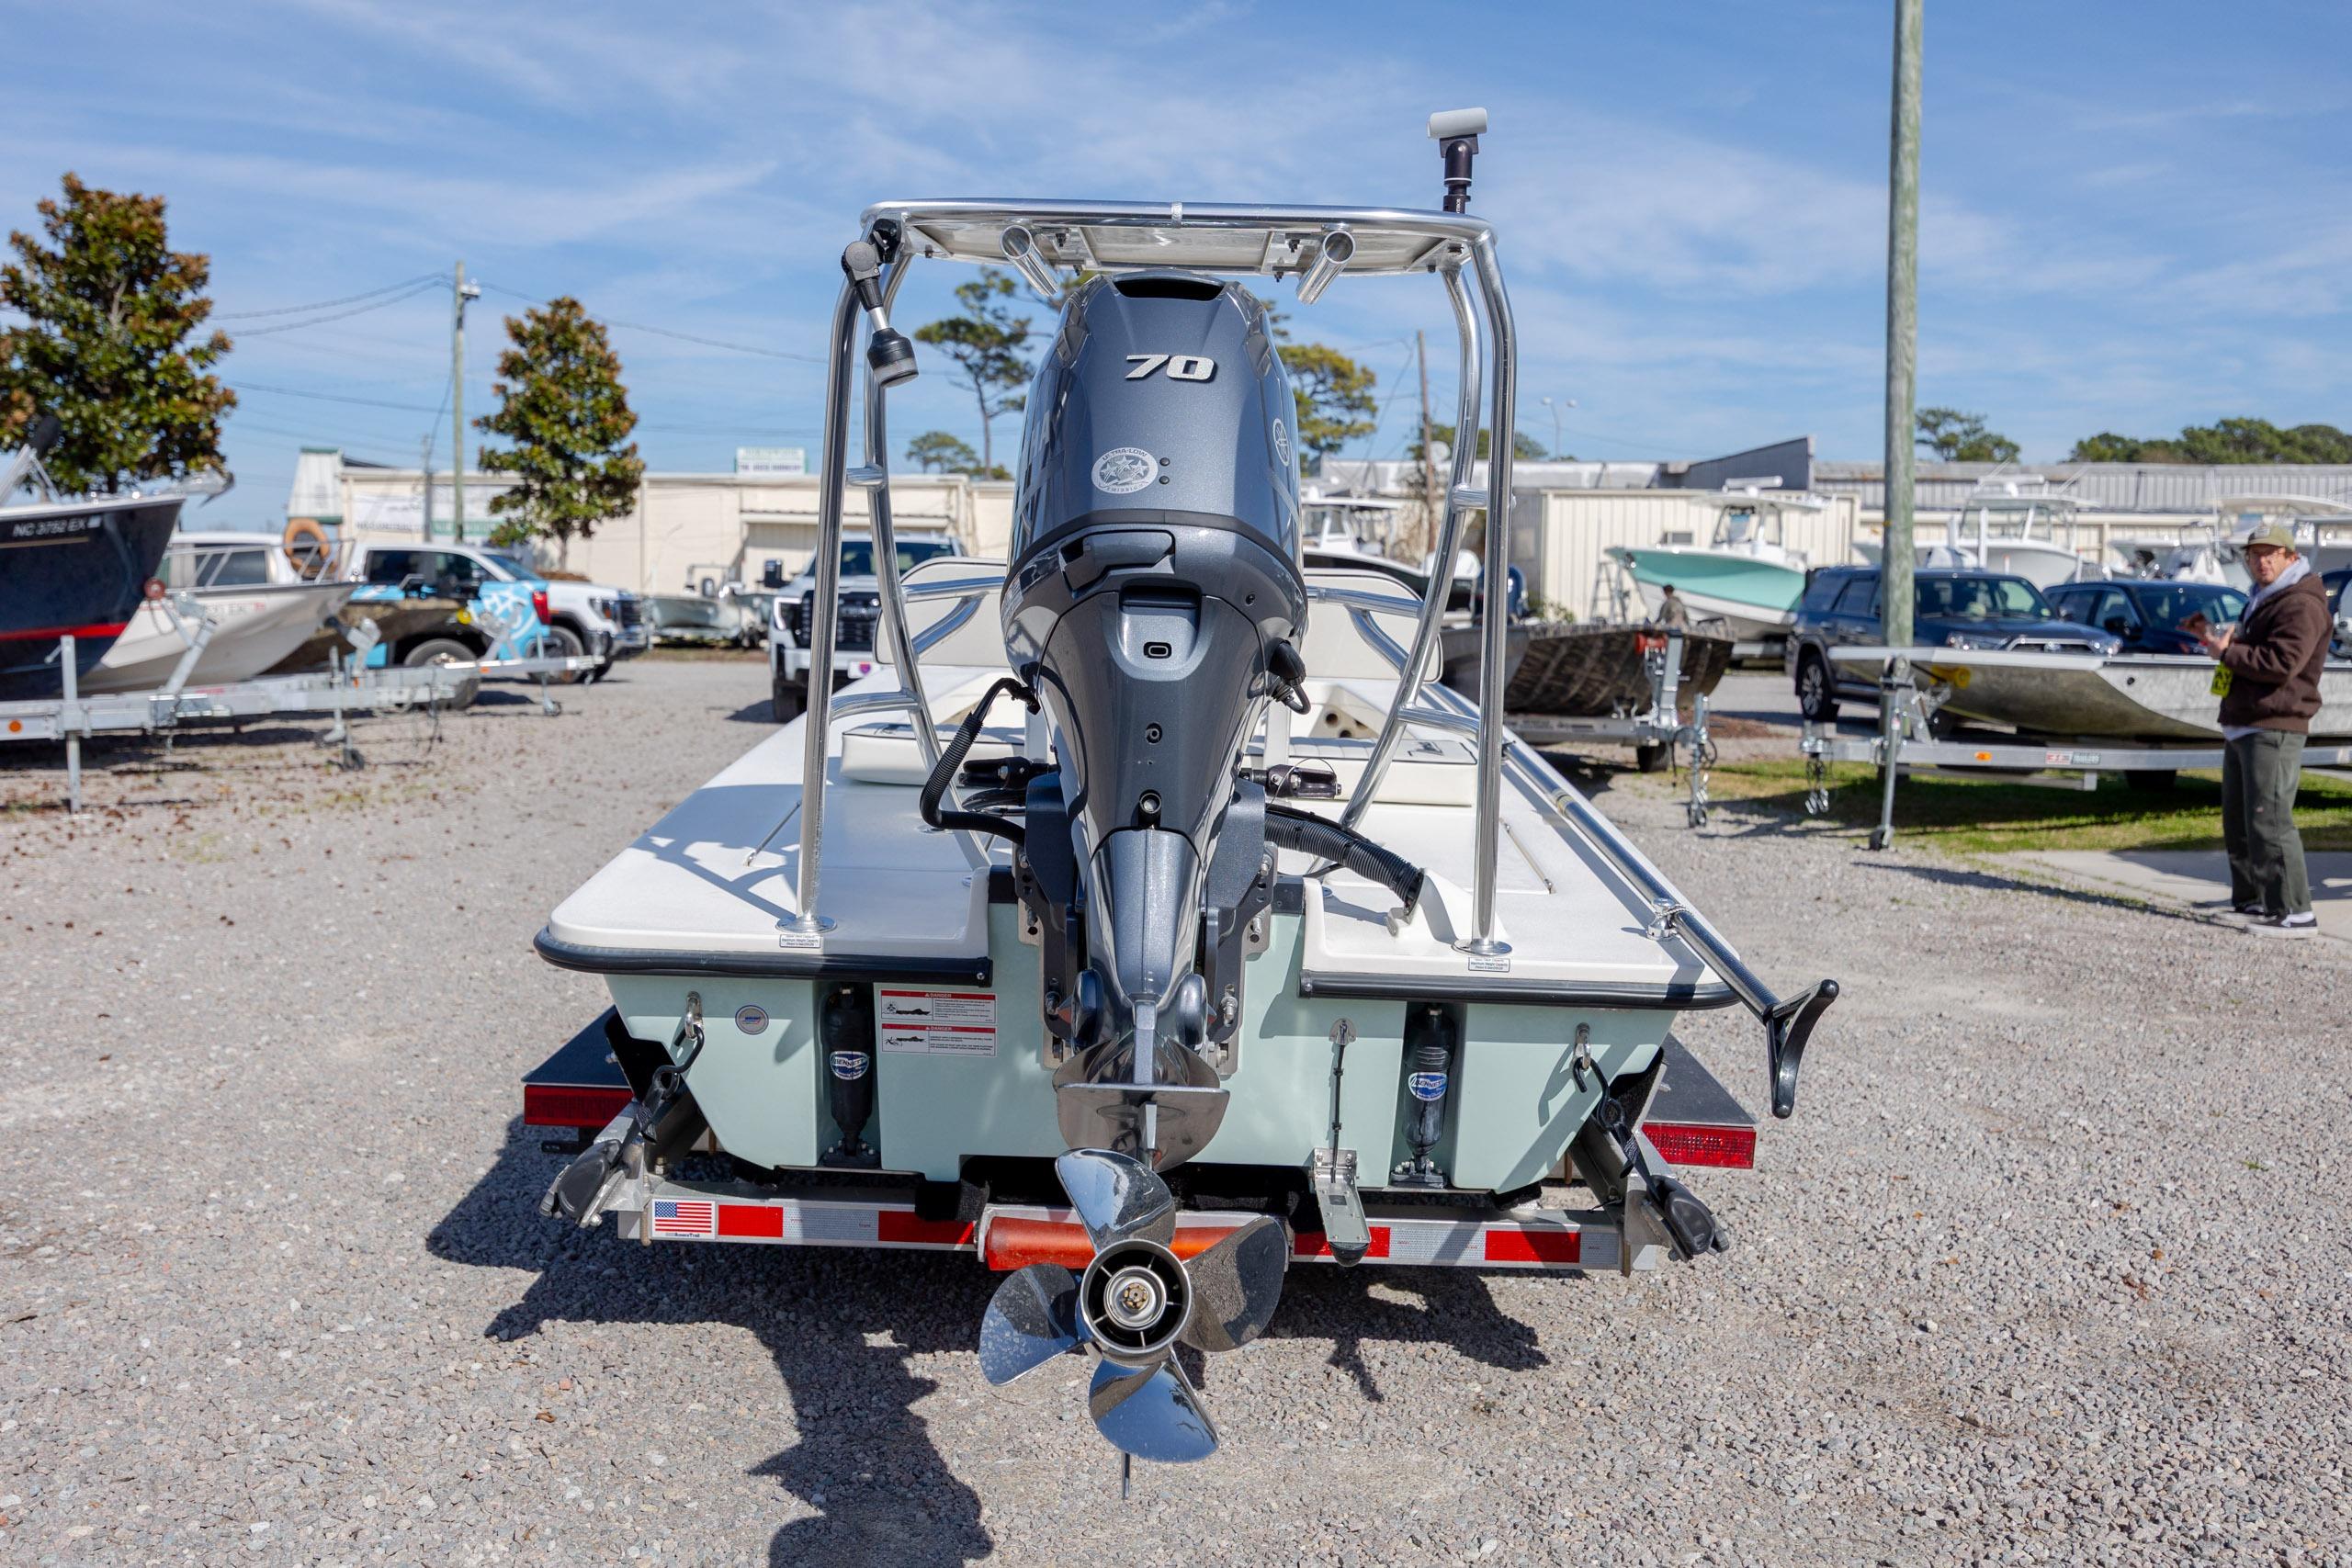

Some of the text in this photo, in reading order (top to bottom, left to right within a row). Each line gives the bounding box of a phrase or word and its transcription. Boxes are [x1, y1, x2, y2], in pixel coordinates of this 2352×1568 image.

[1124, 354, 1215, 380] 70
[13, 522, 35, 537] NC
[1416, 1078, 1443, 1088] BENNET
